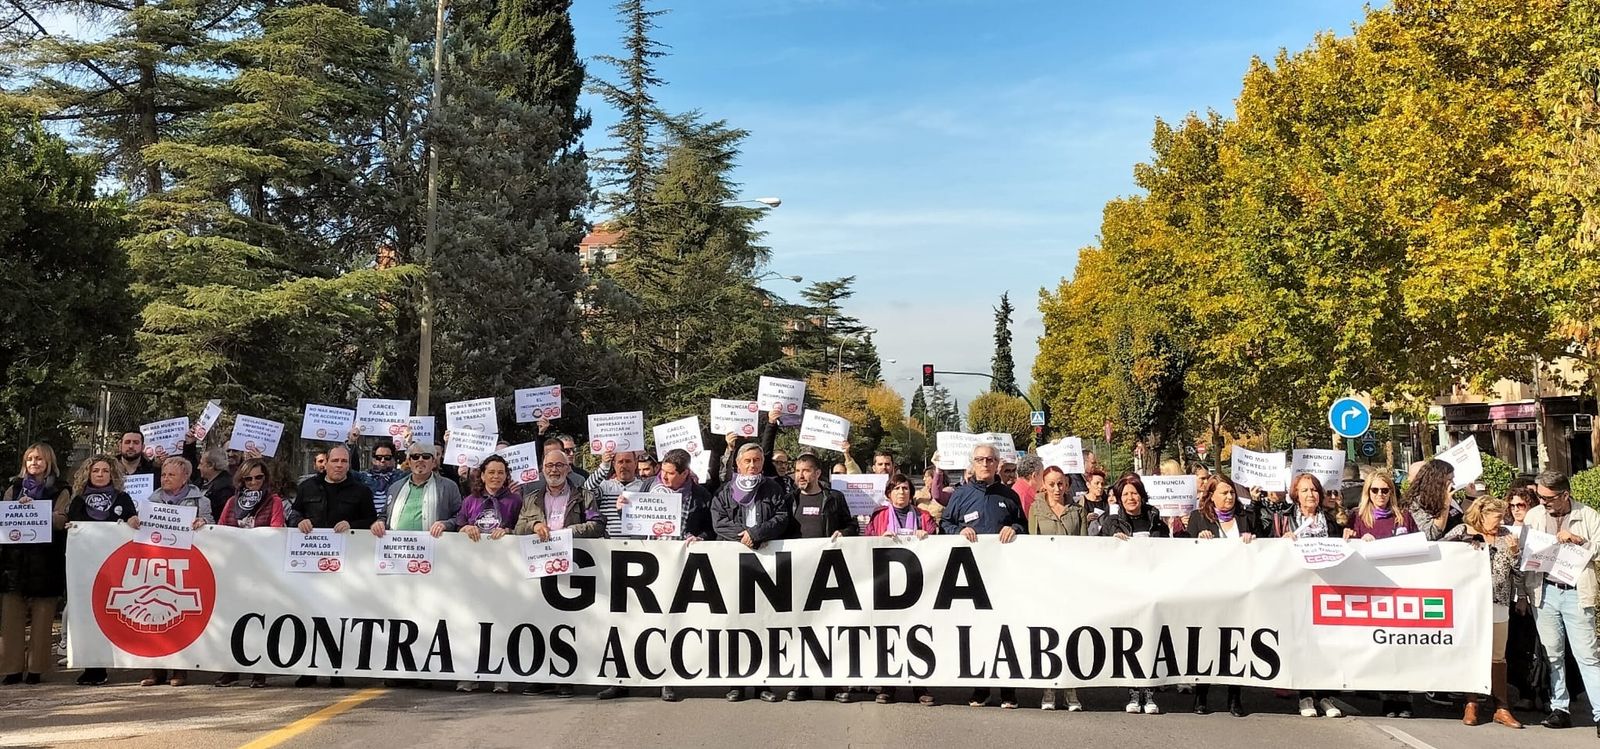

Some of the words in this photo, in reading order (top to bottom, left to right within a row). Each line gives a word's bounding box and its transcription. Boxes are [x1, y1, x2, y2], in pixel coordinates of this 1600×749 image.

[1237, 458, 1266, 470] MUERTES
[153, 506, 179, 514] CARCEL
[140, 520, 190, 532] RESPONSABLES
[121, 558, 190, 587] UGT
[540, 546, 993, 614] GRANADA
[1372, 629, 1454, 645] Granada
[230, 613, 455, 673] CONTRA
[475, 622, 578, 678] LOS
[597, 624, 936, 680] ACCIDENTES
[956, 624, 1281, 681] LABORALES
